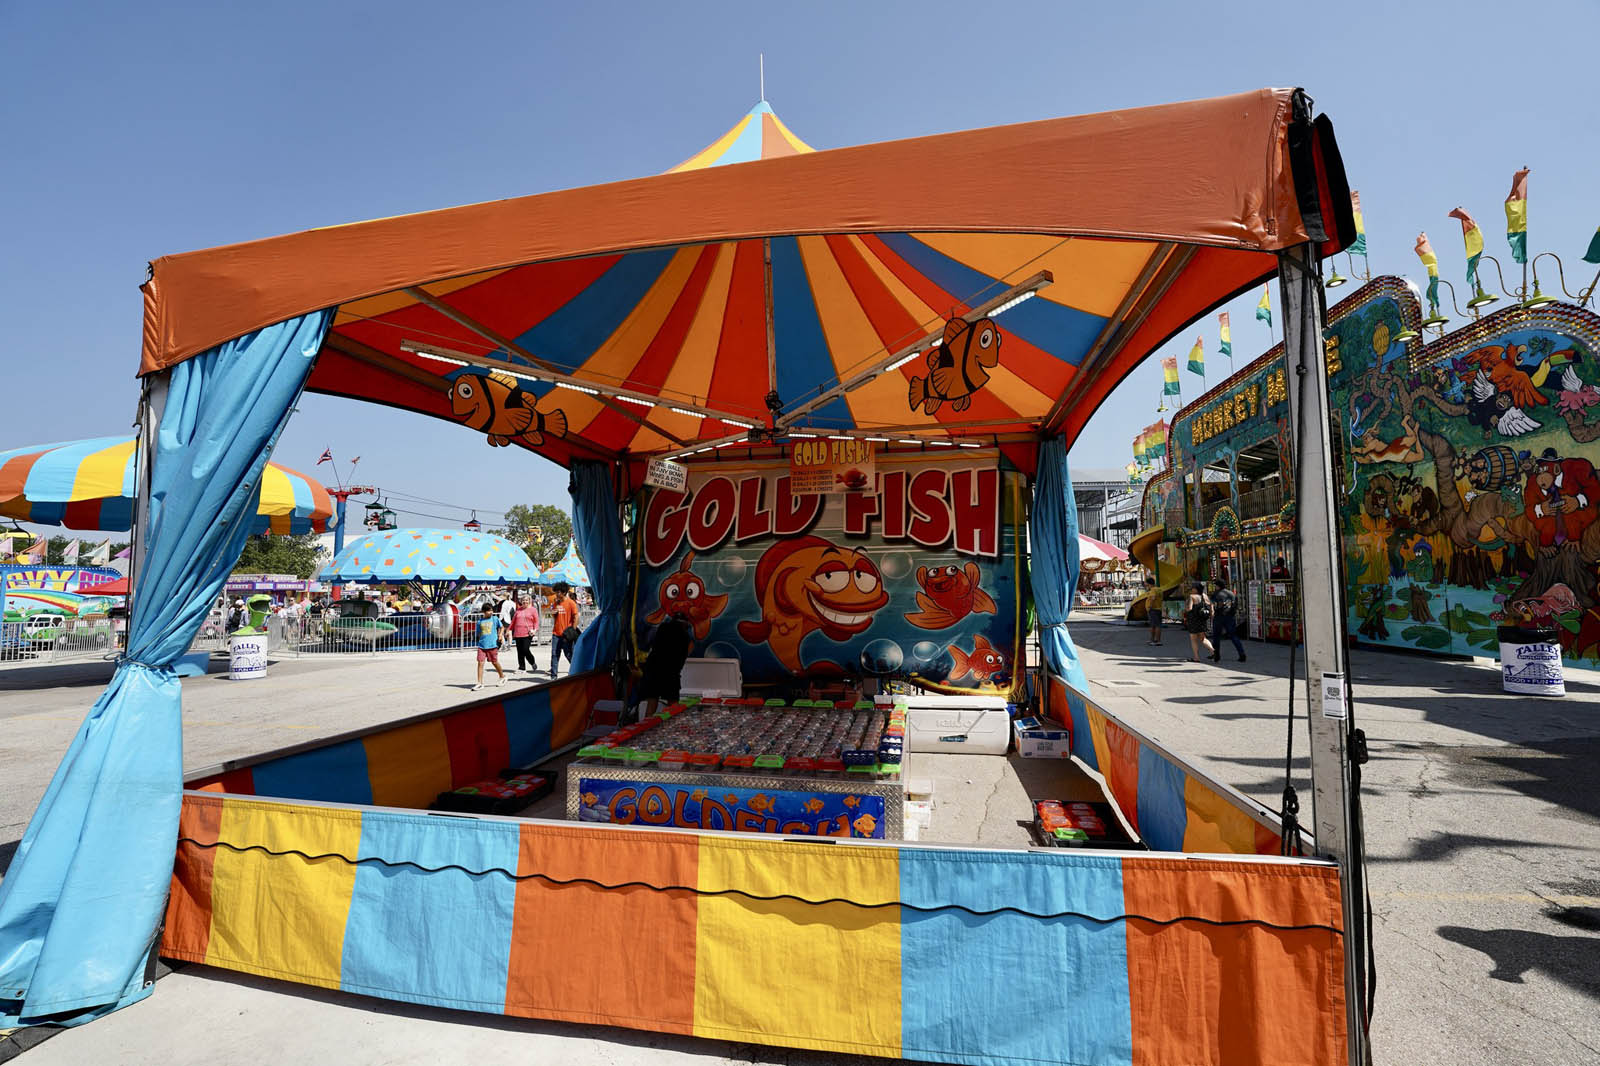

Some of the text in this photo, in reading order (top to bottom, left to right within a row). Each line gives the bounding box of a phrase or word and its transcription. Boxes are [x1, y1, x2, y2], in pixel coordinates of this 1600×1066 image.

[1192, 384, 1259, 446] MONKEY
[794, 440, 870, 465] GOLD FISH!
[643, 466, 1000, 568] GOLD FISH
[233, 642, 260, 653] TALLEY
[1516, 644, 1558, 656] TALLEY
